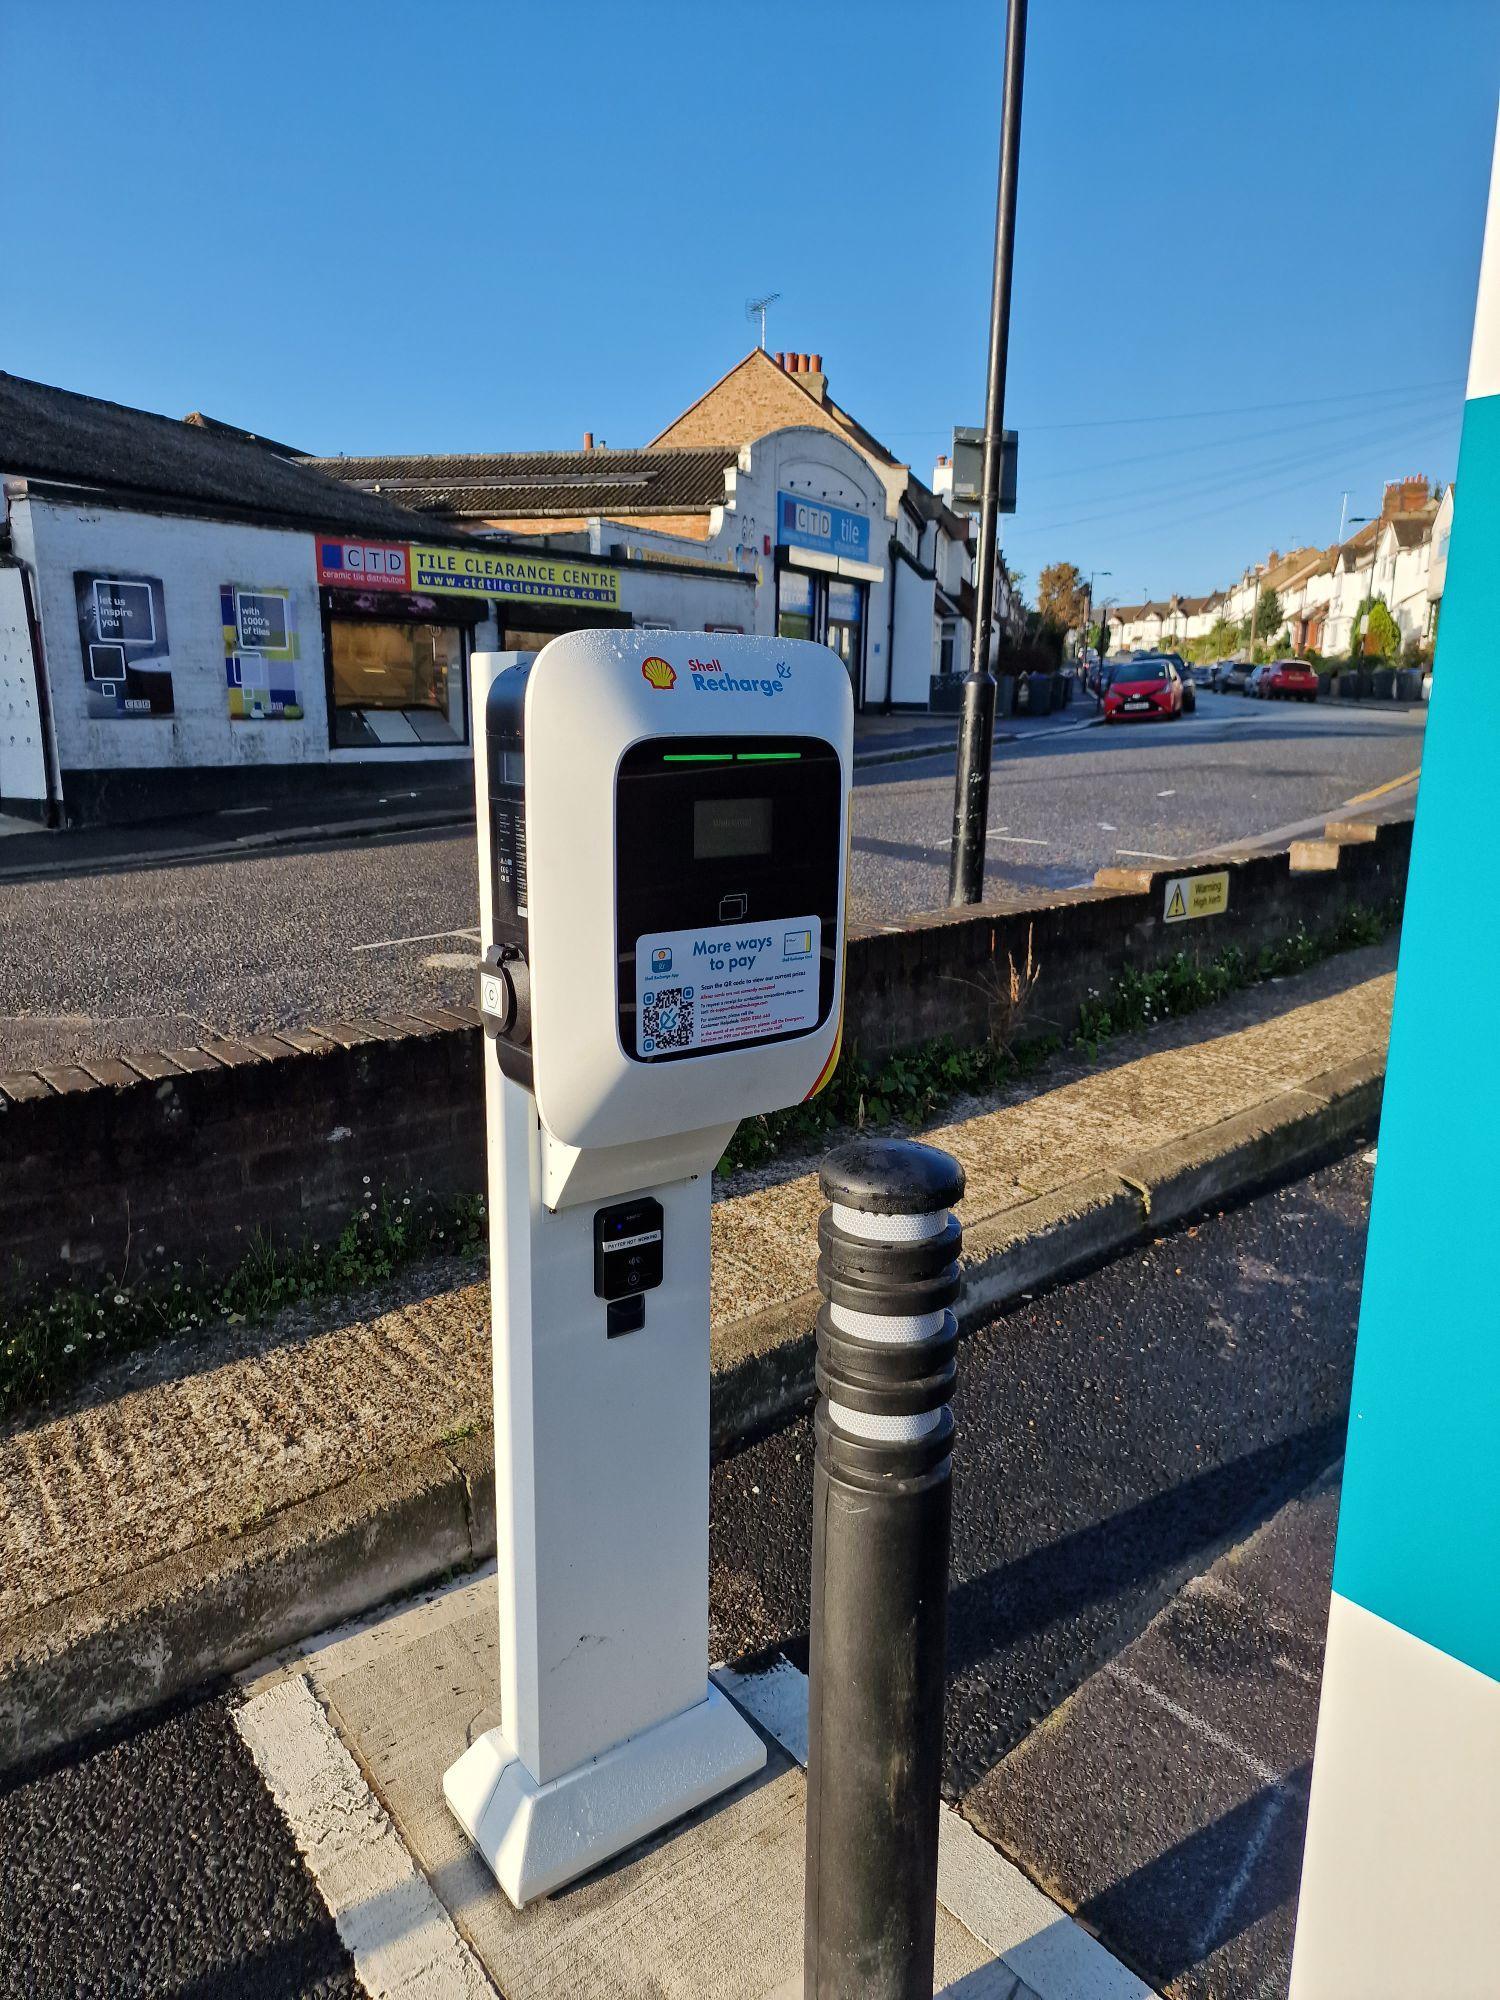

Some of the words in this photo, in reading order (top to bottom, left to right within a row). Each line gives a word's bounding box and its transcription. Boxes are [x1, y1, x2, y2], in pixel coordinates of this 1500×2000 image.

[798, 508, 830, 534] CTD
[841, 519, 859, 544] tile
[348, 549, 402, 570] CTD
[416, 553, 456, 570] TILE
[464, 558, 555, 581] CLEARANCE
[563, 569, 616, 588] CENTRE
[322, 571, 352, 580] ceramic
[353, 573, 365, 581] tile
[366, 574, 406, 585] distributors
[421, 574, 616, 602] www.ctdtileclearance.co.uk
[99, 595, 112, 605] let
[114, 598, 126, 606] us
[100, 606, 133, 618] inspire
[241, 608, 260, 616] with
[101, 619, 120, 628] you
[243, 617, 270, 627] 1000's
[243, 627, 251, 635] of
[253, 627, 271, 636] tiles
[688, 659, 722, 672] Shell
[691, 673, 784, 697] Recharge
[1194, 882, 1222, 894] Warning
[1193, 898, 1207, 908] High
[692, 940, 732, 956] More
[736, 936, 773, 953] ways
[709, 957, 725, 971] to
[729, 955, 757, 972] pay
[489, 989, 494, 1001] C
[626, 1238, 636, 1246] NOT
[638, 1232, 658, 1242] WORKING
